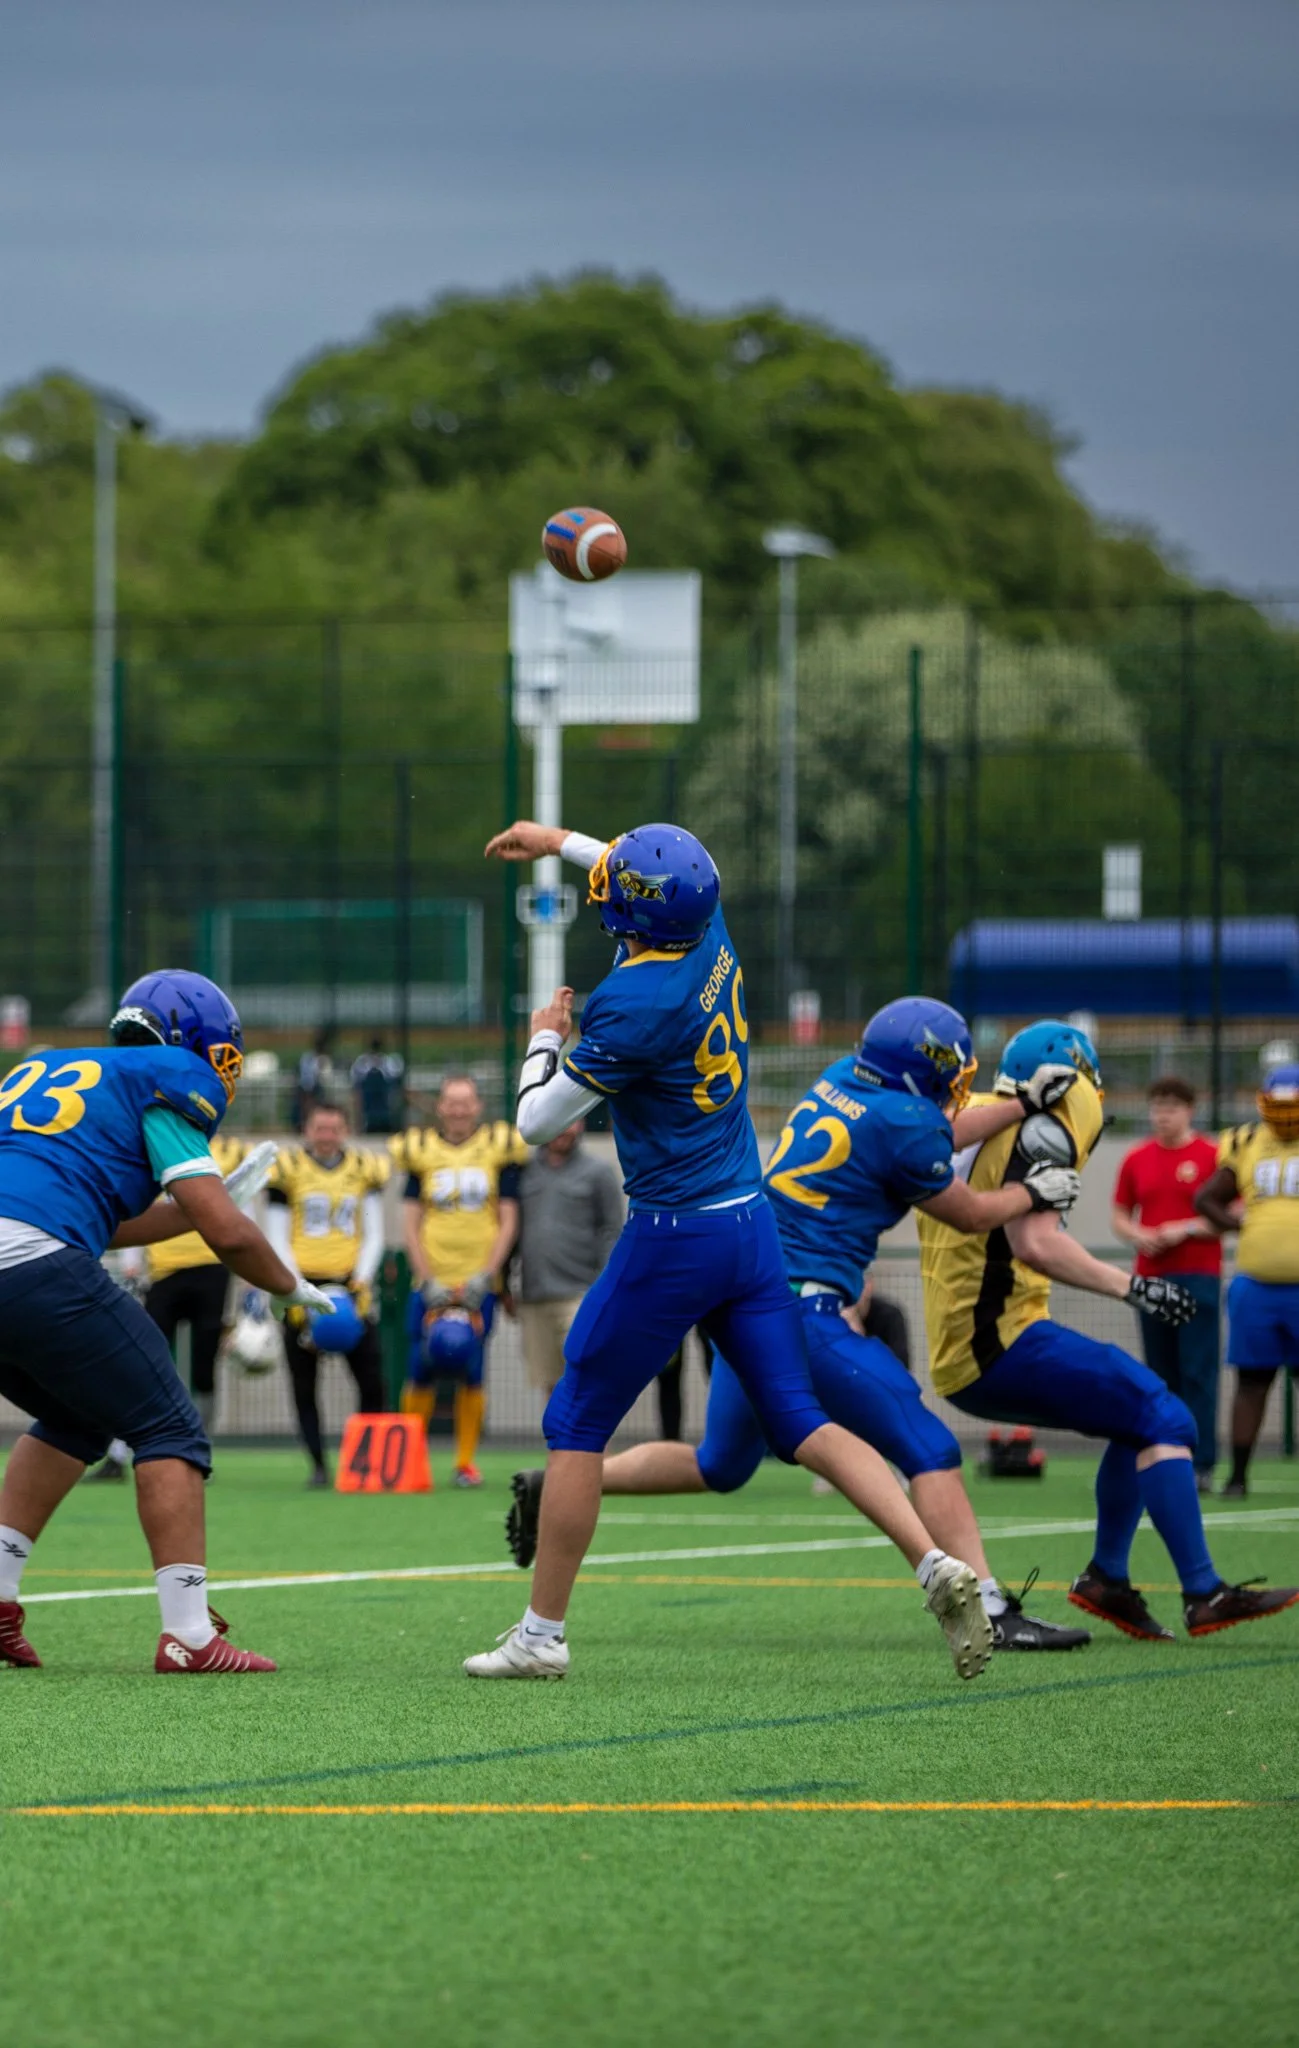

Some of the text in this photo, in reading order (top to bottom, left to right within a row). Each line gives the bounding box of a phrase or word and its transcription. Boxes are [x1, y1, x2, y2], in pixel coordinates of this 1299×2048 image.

[699, 944, 735, 1014] GEORGE
[0, 1059, 103, 1135] 93
[813, 1079, 868, 1121] WILLIAMS
[349, 1424, 408, 1490] 40
